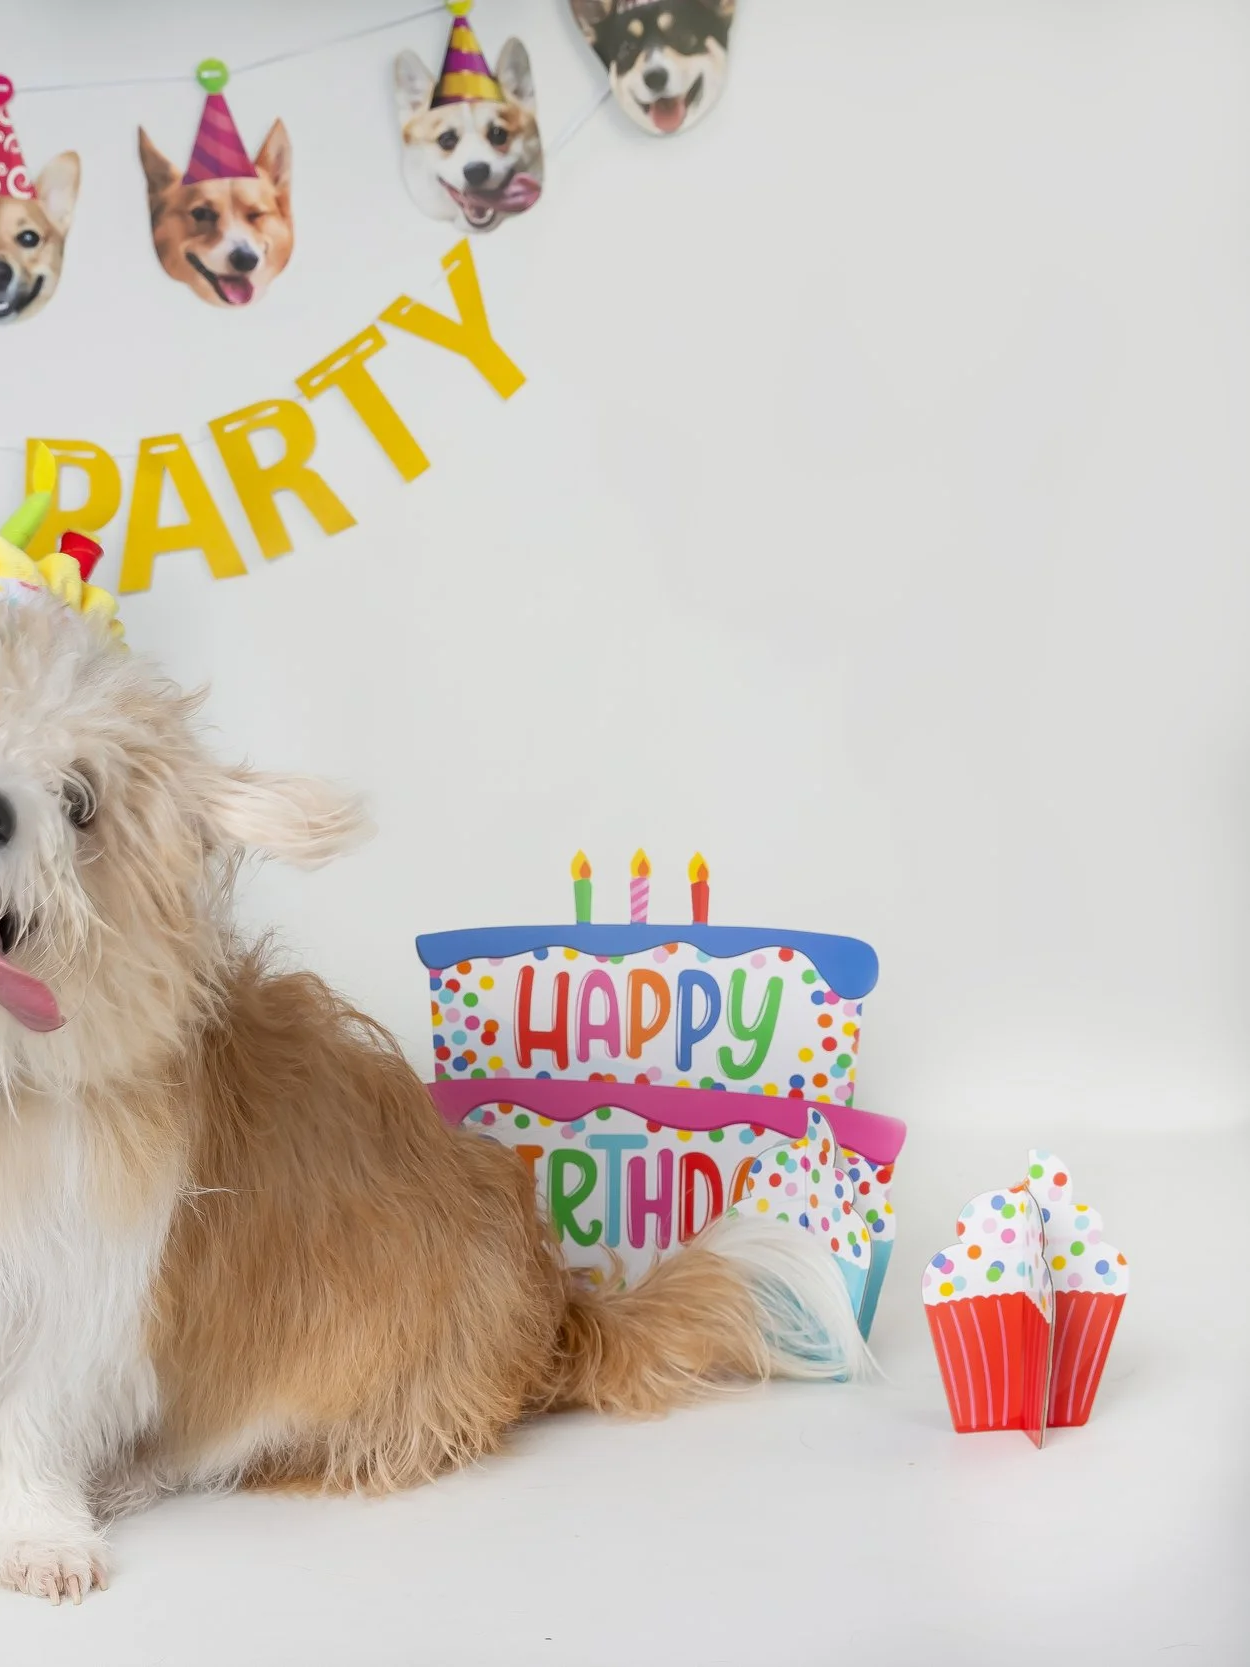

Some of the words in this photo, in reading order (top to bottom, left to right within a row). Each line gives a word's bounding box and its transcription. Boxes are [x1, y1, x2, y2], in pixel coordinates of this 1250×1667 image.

[24, 237, 527, 595] PARTY
[513, 965, 784, 1081] HAPPY
[516, 1134, 756, 1249] RTHD
